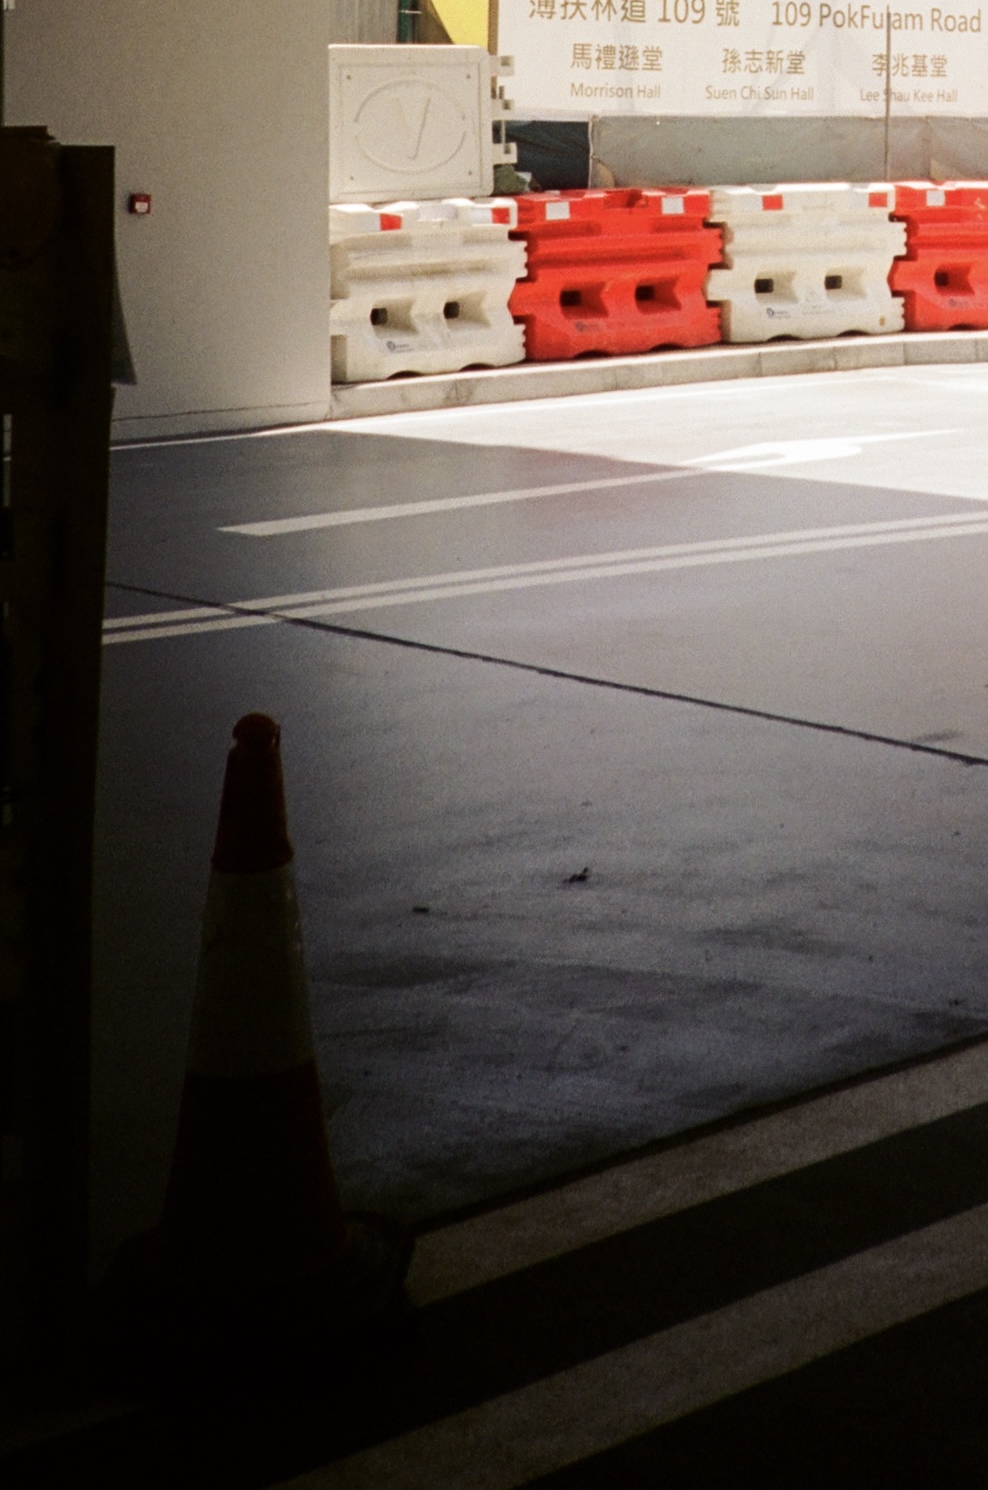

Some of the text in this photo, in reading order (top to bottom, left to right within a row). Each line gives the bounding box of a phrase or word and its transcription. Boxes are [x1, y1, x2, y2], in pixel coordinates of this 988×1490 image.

[772, 0, 812, 27] 109
[931, 7, 981, 32] Road
[570, 42, 663, 71] 馬禮遜堂
[722, 48, 806, 74] 孫志新堂
[872, 53, 947, 77] 李兆基堂
[570, 83, 661, 99] Morrison Hall
[705, 85, 814, 100] Suen Chi Sun Hall
[860, 89, 880, 102] Lee
[914, 89, 934, 102] Kee
[937, 89, 958, 102] Hall
